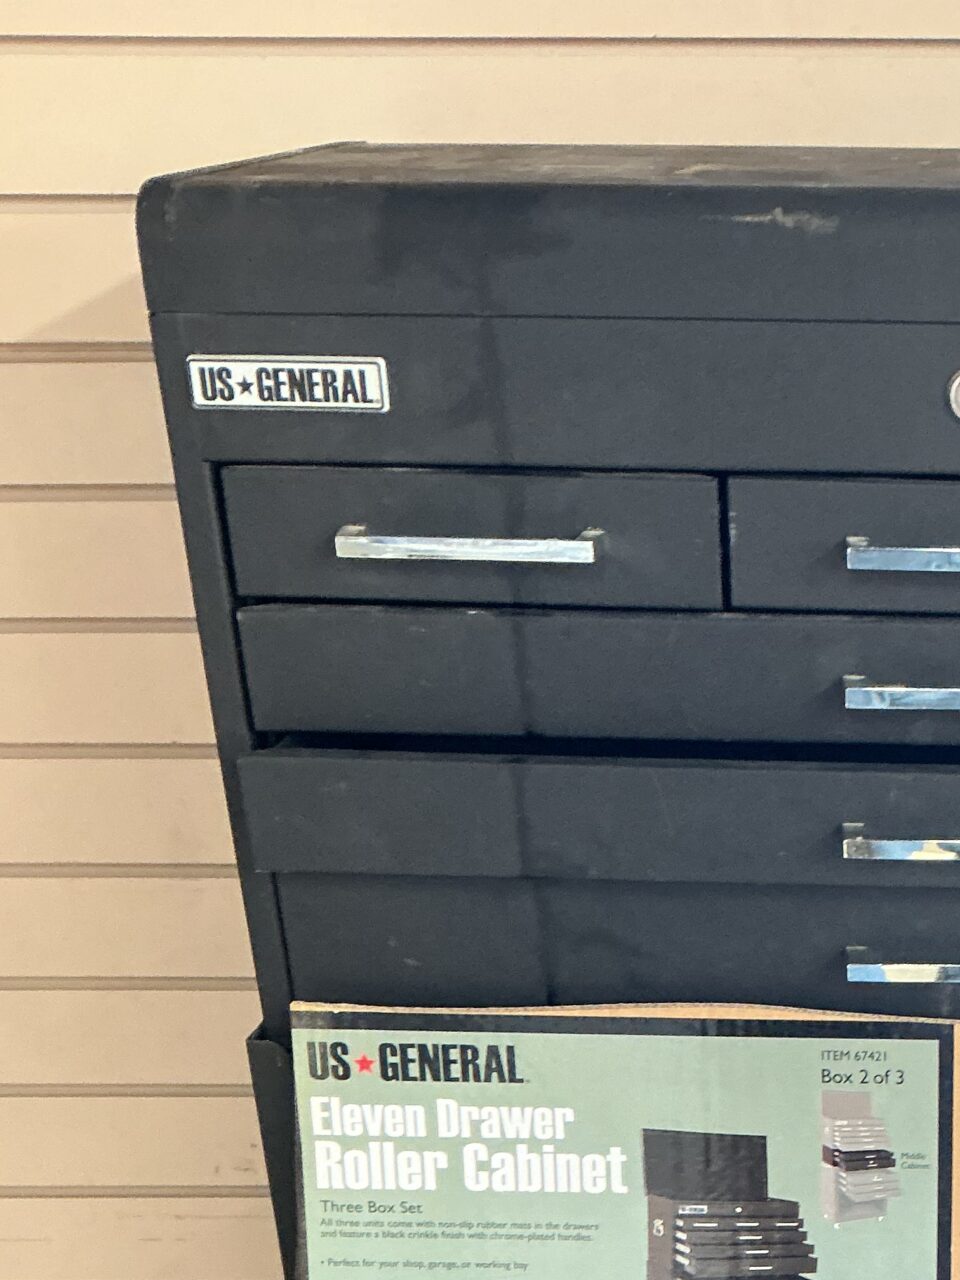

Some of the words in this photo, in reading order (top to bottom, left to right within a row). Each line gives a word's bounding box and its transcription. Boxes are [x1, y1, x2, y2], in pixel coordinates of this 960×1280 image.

[198, 366, 235, 401] US
[256, 367, 374, 403] GENERAL
[307, 1042, 351, 1081] US
[379, 1043, 524, 1083] GENERAL
[821, 1050, 851, 1061] ITEM
[854, 1051, 887, 1061] 67421
[821, 1068, 853, 1084] Box
[860, 1069, 869, 1084] 2
[873, 1069, 891, 1084] of
[896, 1069, 905, 1085] 3
[310, 1096, 427, 1138] Eleven
[436, 1098, 574, 1140] Drawer
[315, 1140, 448, 1191] Roller
[463, 1143, 629, 1194] Cabinet
[320, 1200, 363, 1213] Three
[367, 1201, 396, 1214] Box
[400, 1201, 423, 1214] Set
